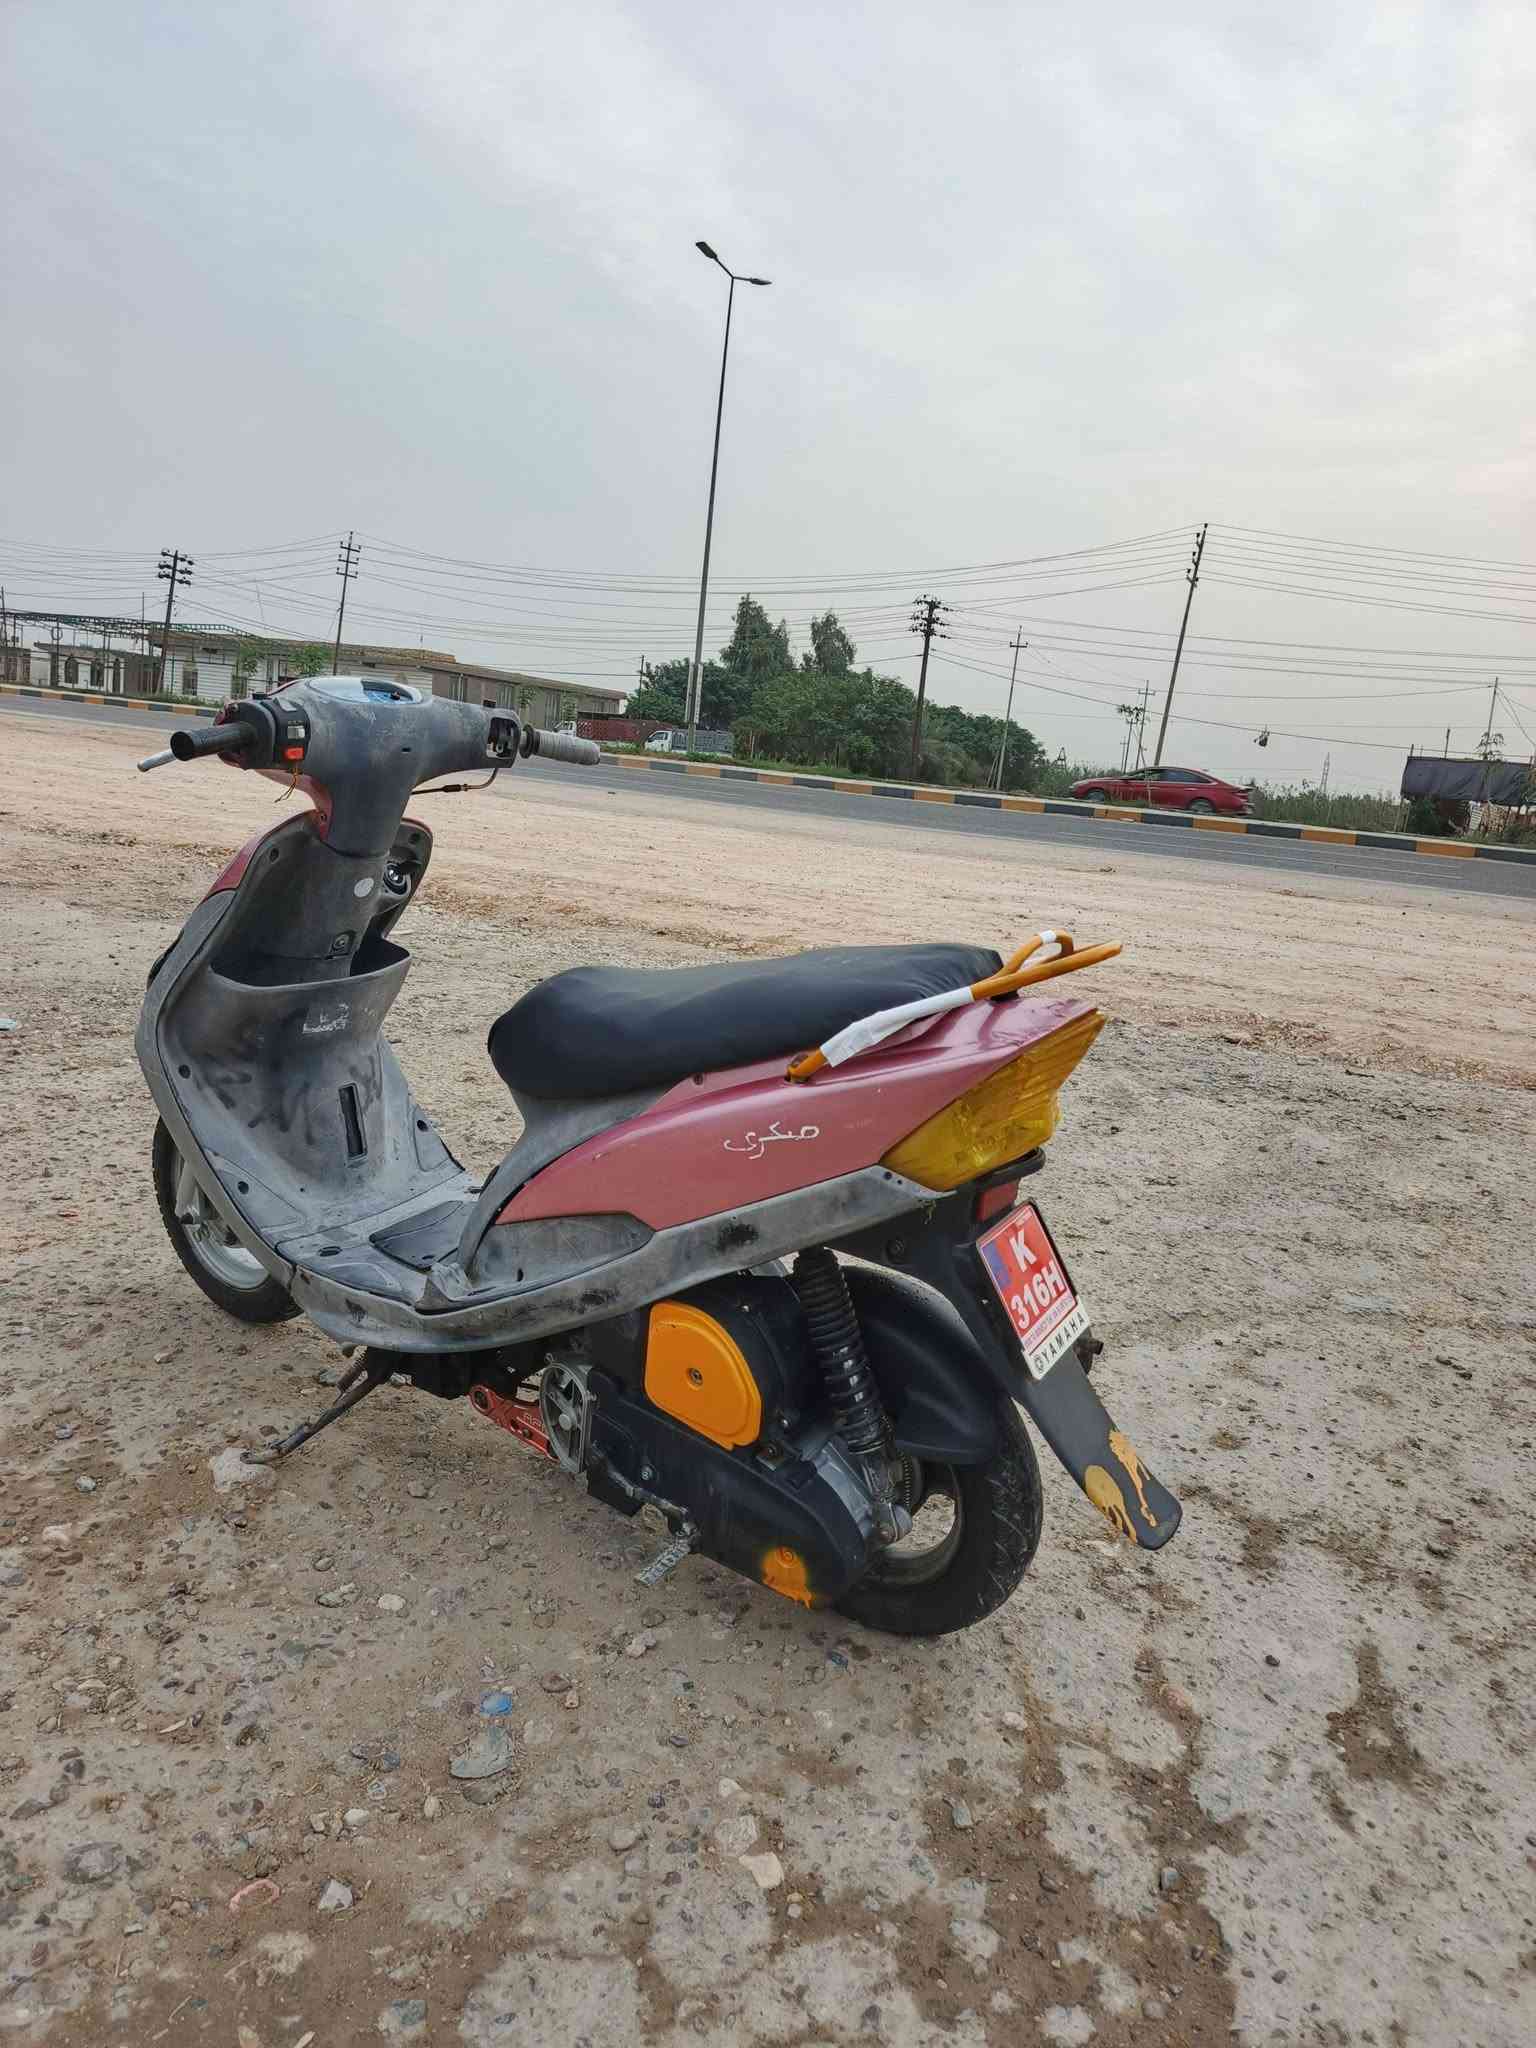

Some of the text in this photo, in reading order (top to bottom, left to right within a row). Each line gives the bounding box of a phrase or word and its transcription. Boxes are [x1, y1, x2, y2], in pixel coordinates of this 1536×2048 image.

[1009, 1230, 1037, 1273] K
[1010, 1261, 1067, 1329] 316H
[1041, 1311, 1085, 1363] YAMAHA
